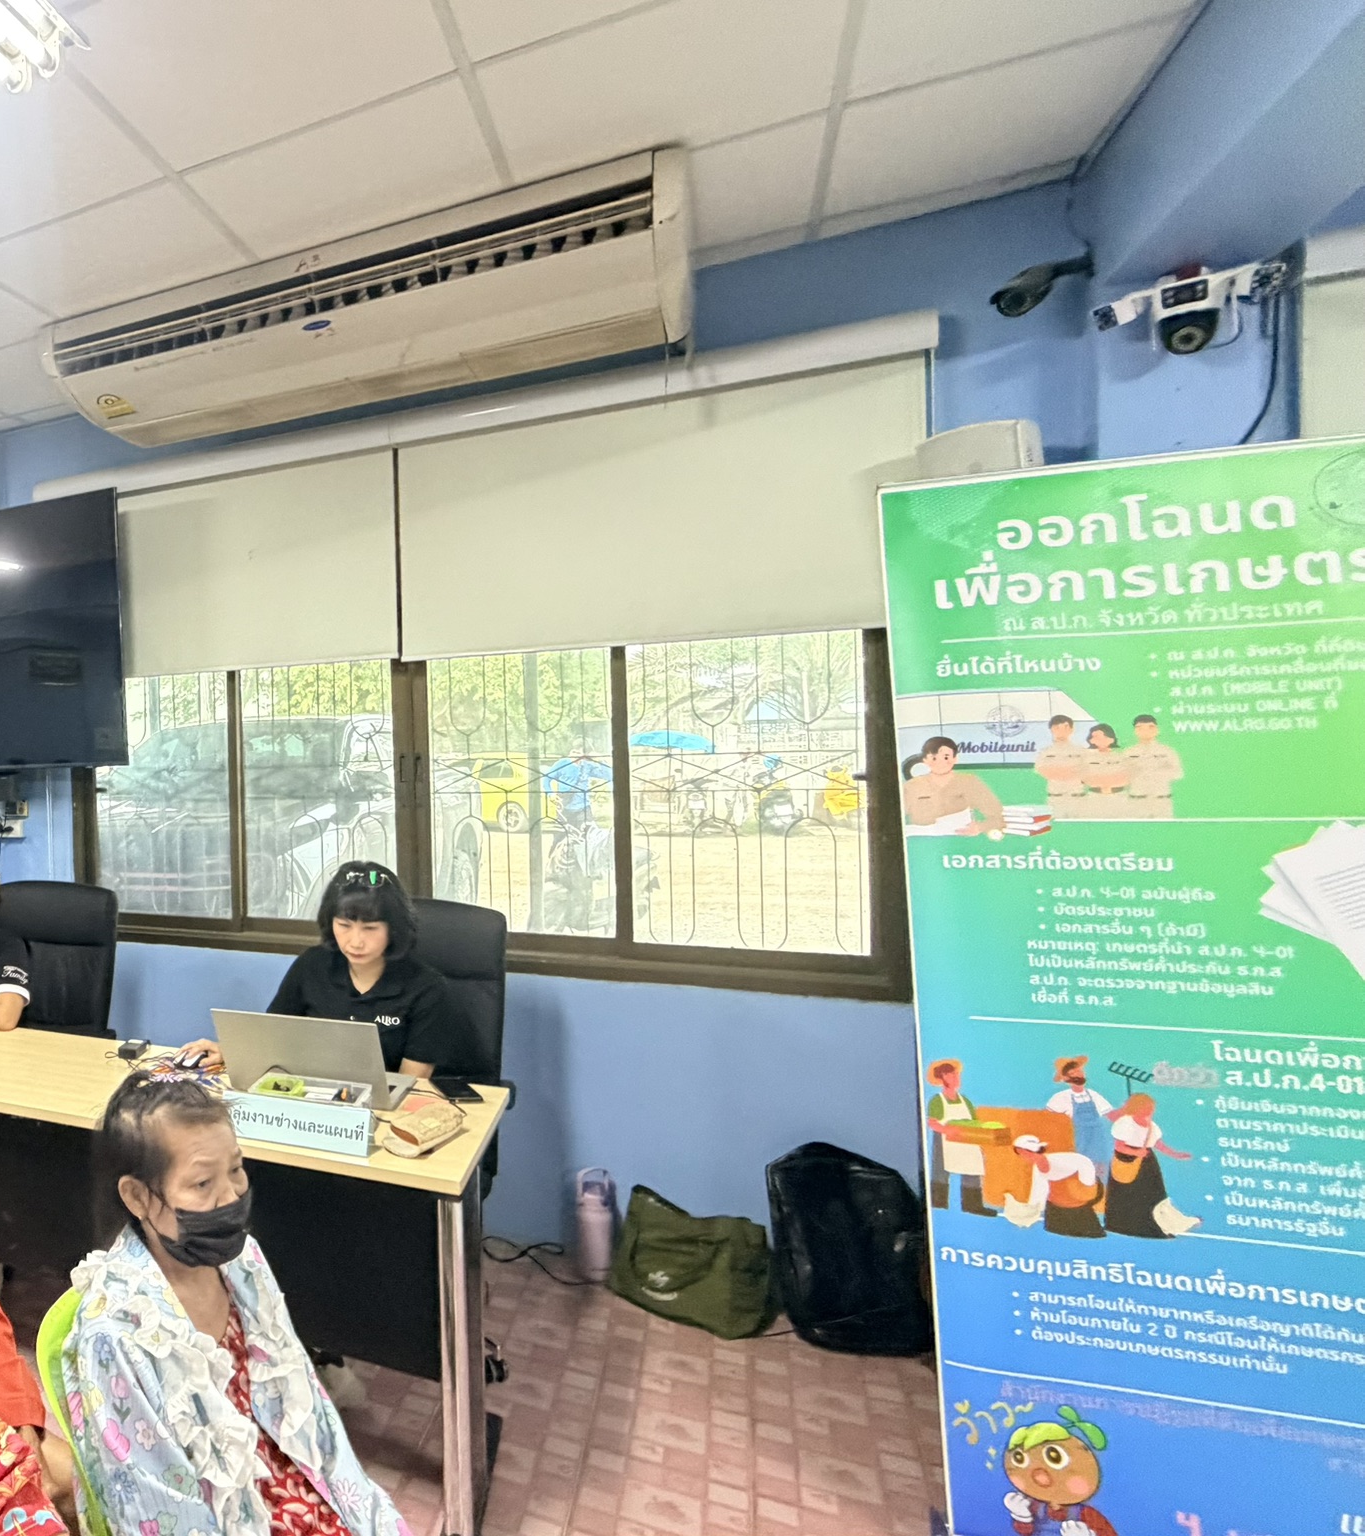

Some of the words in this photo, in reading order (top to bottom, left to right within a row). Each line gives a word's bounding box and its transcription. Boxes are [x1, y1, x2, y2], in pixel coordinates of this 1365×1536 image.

[996, 493, 1297, 551] ออกโฉนด
[1004, 616, 1026, 633] ณ
[1031, 611, 1093, 631] ส.ป.ก.
[1099, 605, 1178, 628] จังหวัด
[1185, 597, 1325, 625] ทั่วประเทศ
[936, 652, 1102, 678] ยื่นได้ที่ไหนบ้าง
[1255, 696, 1317, 713] ONLINE
[957, 740, 1037, 754] Mobileunit
[942, 845, 1174, 872] เอกสารที่ต้องเตรียม
[1053, 902, 1155, 918] บัตรประชาชน
[1055, 918, 1133, 936] เอกสารอื่น
[1210, 1039, 1365, 1071] โฉนดเพื่อก
[229, 1105, 366, 1143] ลุ่มงานช่างและแผนที่
[1218, 1135, 1292, 1153] ธนารักษ์
[1220, 1151, 1365, 1179] เป็นหลักทรัพย์ค้
[1222, 1174, 1256, 1188] จาก
[1226, 1212, 1346, 1238] ธนาคารรัฐอื่น
[1030, 1307, 1141, 1334] ห้ามโอนภายใน
[1146, 1322, 1159, 1337] 2
[1164, 1322, 1178, 1340] ปี
[1031, 1326, 1288, 1375] ต้องประกอบเกษตรกรรมเท่านั้น
